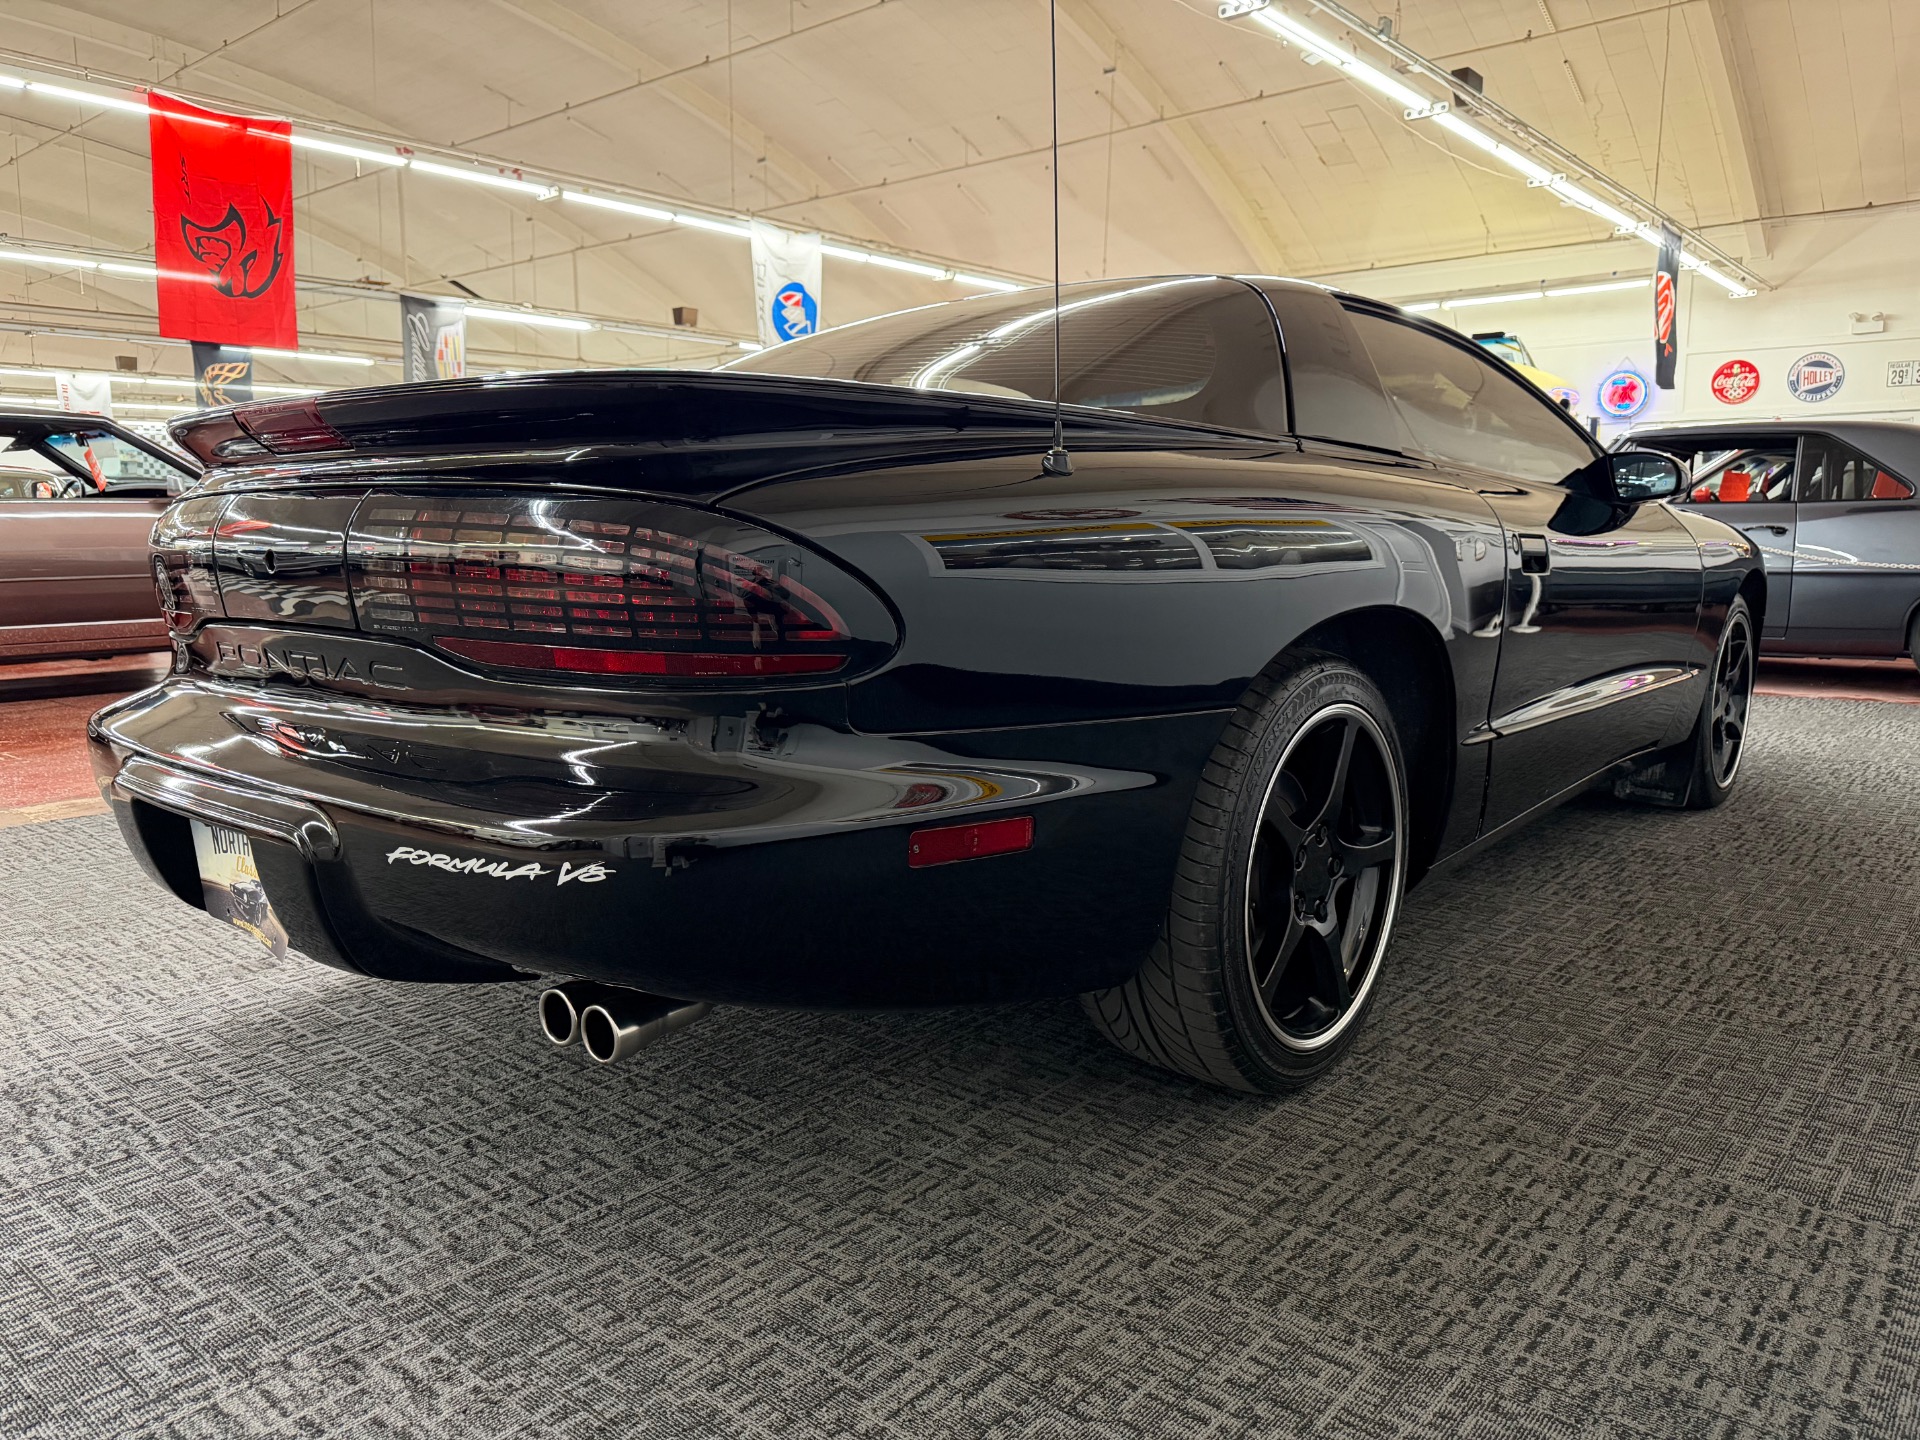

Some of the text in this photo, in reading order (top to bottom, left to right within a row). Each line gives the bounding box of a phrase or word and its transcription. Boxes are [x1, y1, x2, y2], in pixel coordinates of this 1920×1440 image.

[1803, 370, 1834, 387] HOLLEY
[216, 641, 410, 690] PONTIAC
[210, 826, 251, 857] NORTH
[386, 846, 617, 886] FORMULA V8
